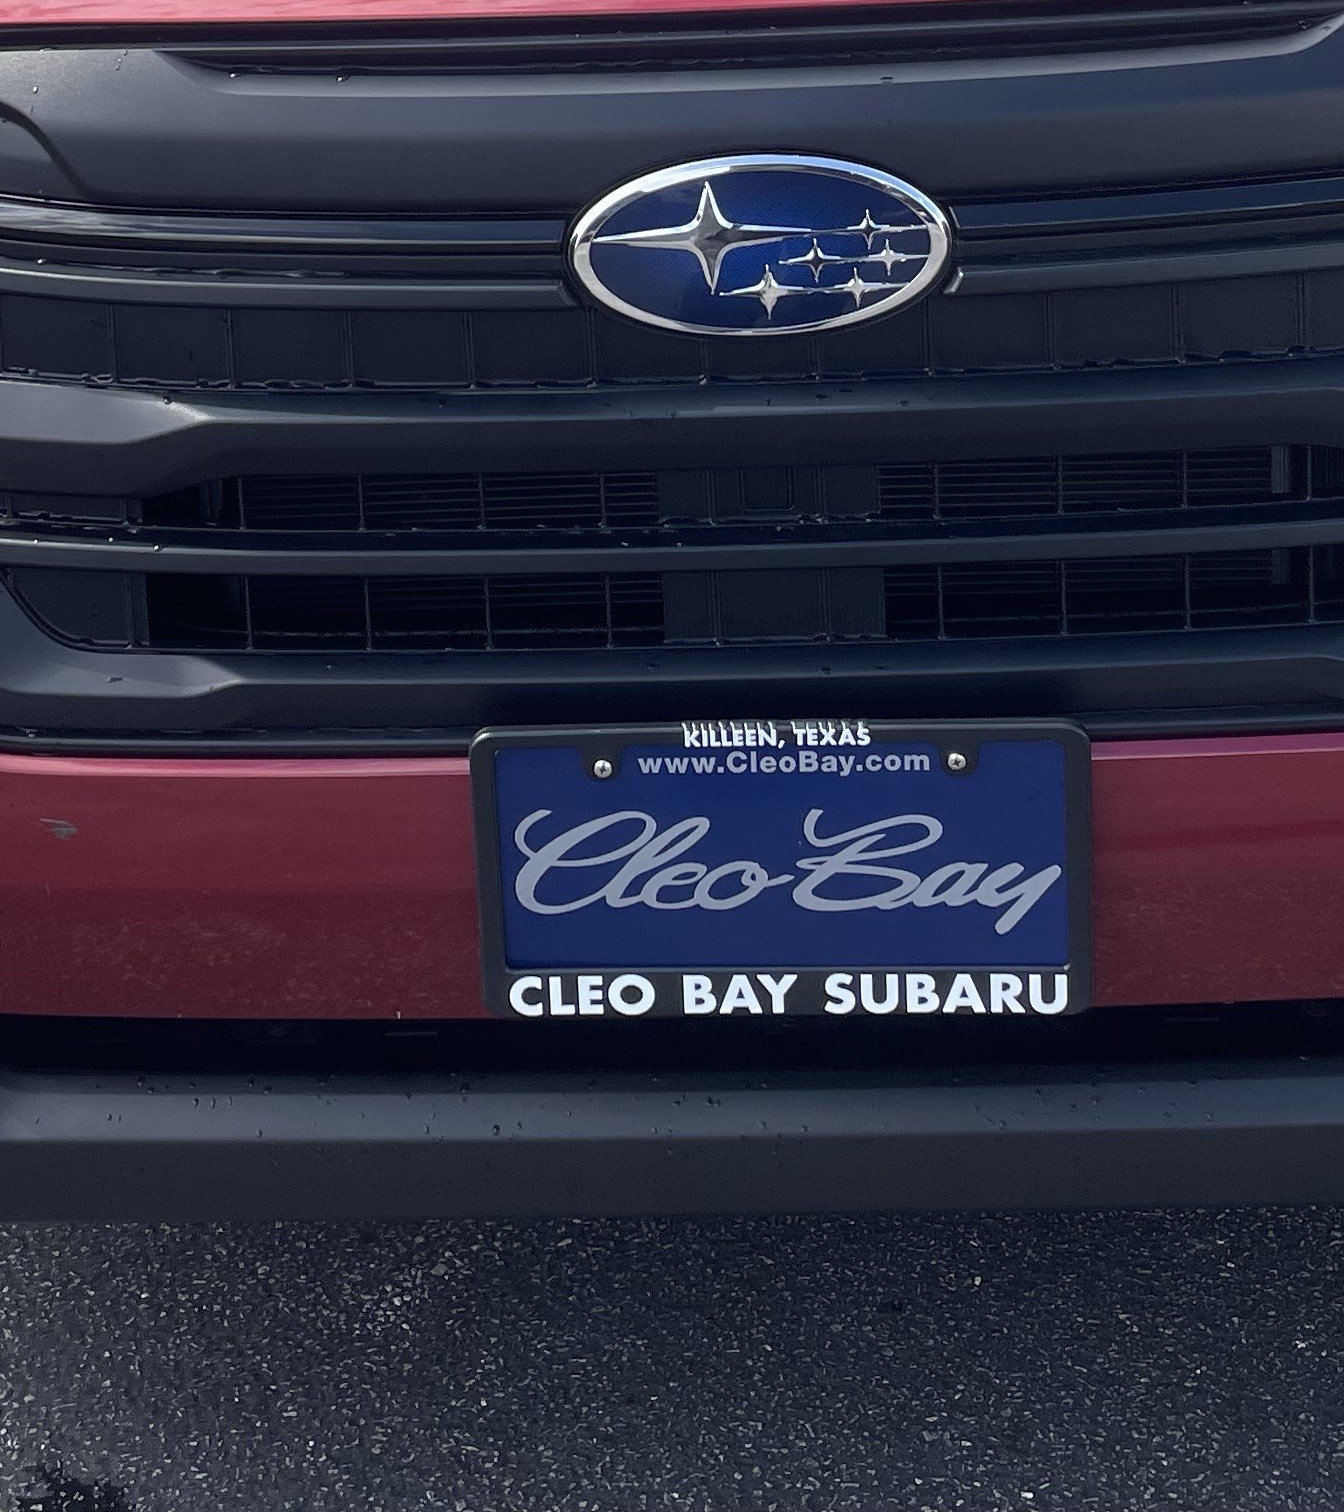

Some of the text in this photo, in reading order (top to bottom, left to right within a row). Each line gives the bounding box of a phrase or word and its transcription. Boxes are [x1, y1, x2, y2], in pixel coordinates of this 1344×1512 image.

[681, 721, 871, 749] KILLEEN, TEXAS
[637, 750, 931, 777] www.CleoBay.com
[514, 808, 1062, 935] Cleo Bay
[508, 972, 1070, 1017] CLEO BAY SUBARU
